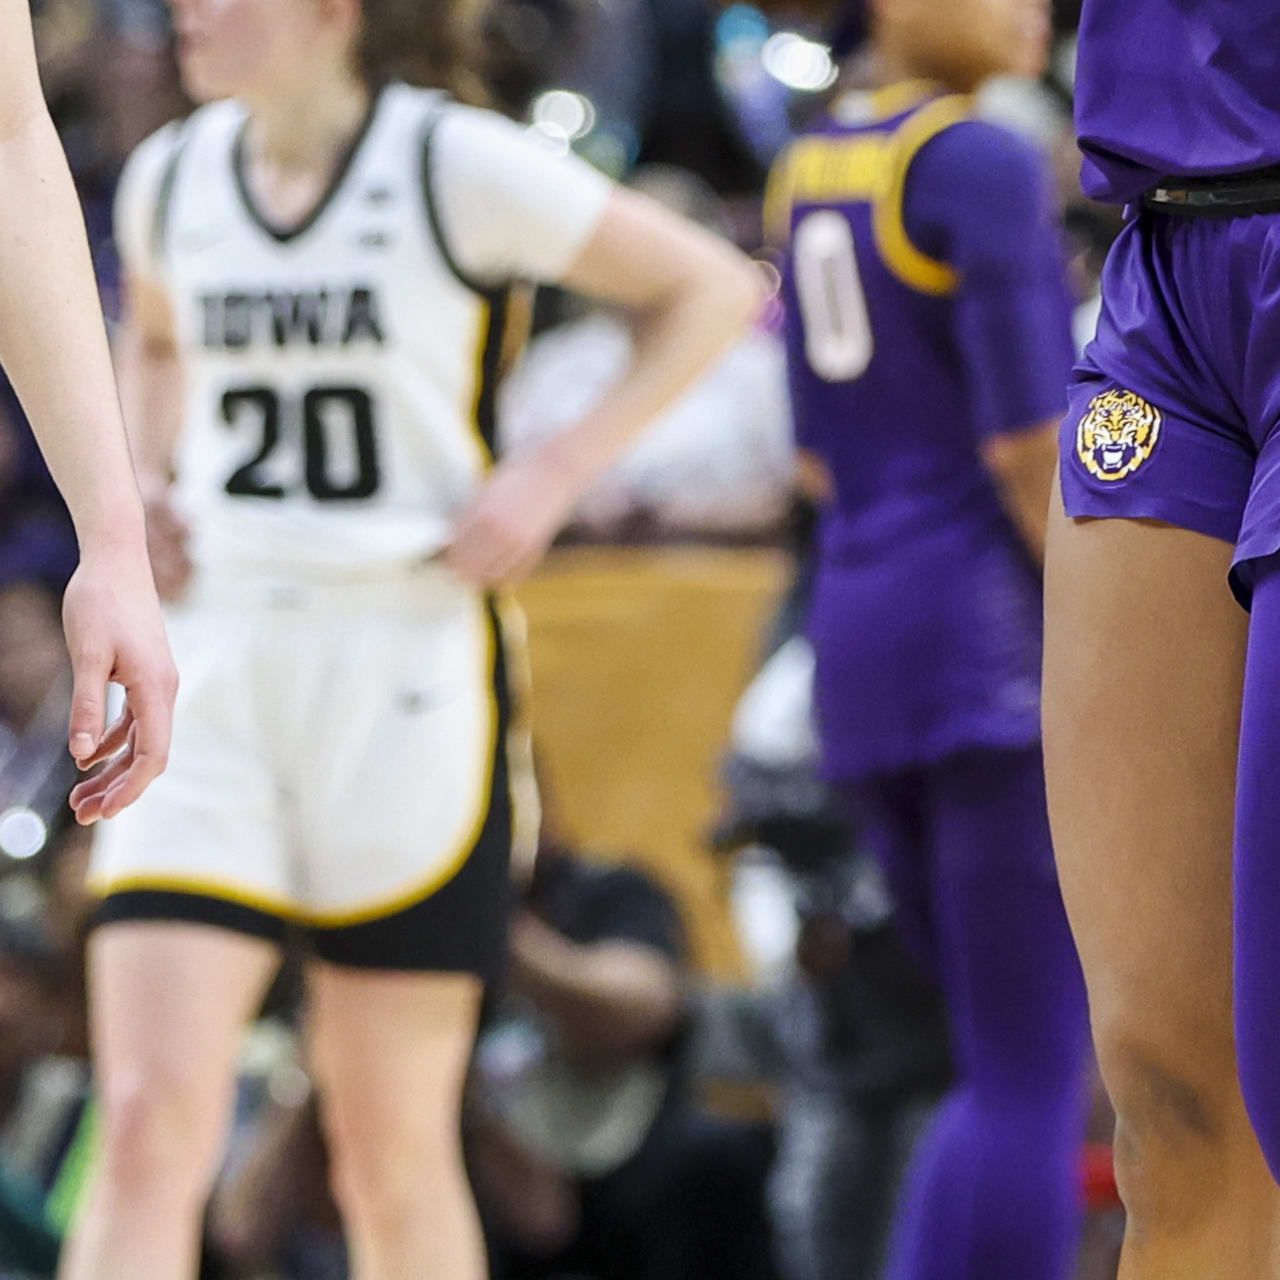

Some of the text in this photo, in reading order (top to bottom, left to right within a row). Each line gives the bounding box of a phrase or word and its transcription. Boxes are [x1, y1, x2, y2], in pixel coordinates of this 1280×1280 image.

[200, 287, 384, 347] IOWA
[793, 209, 873, 382] 0
[219, 386, 380, 500] 20
